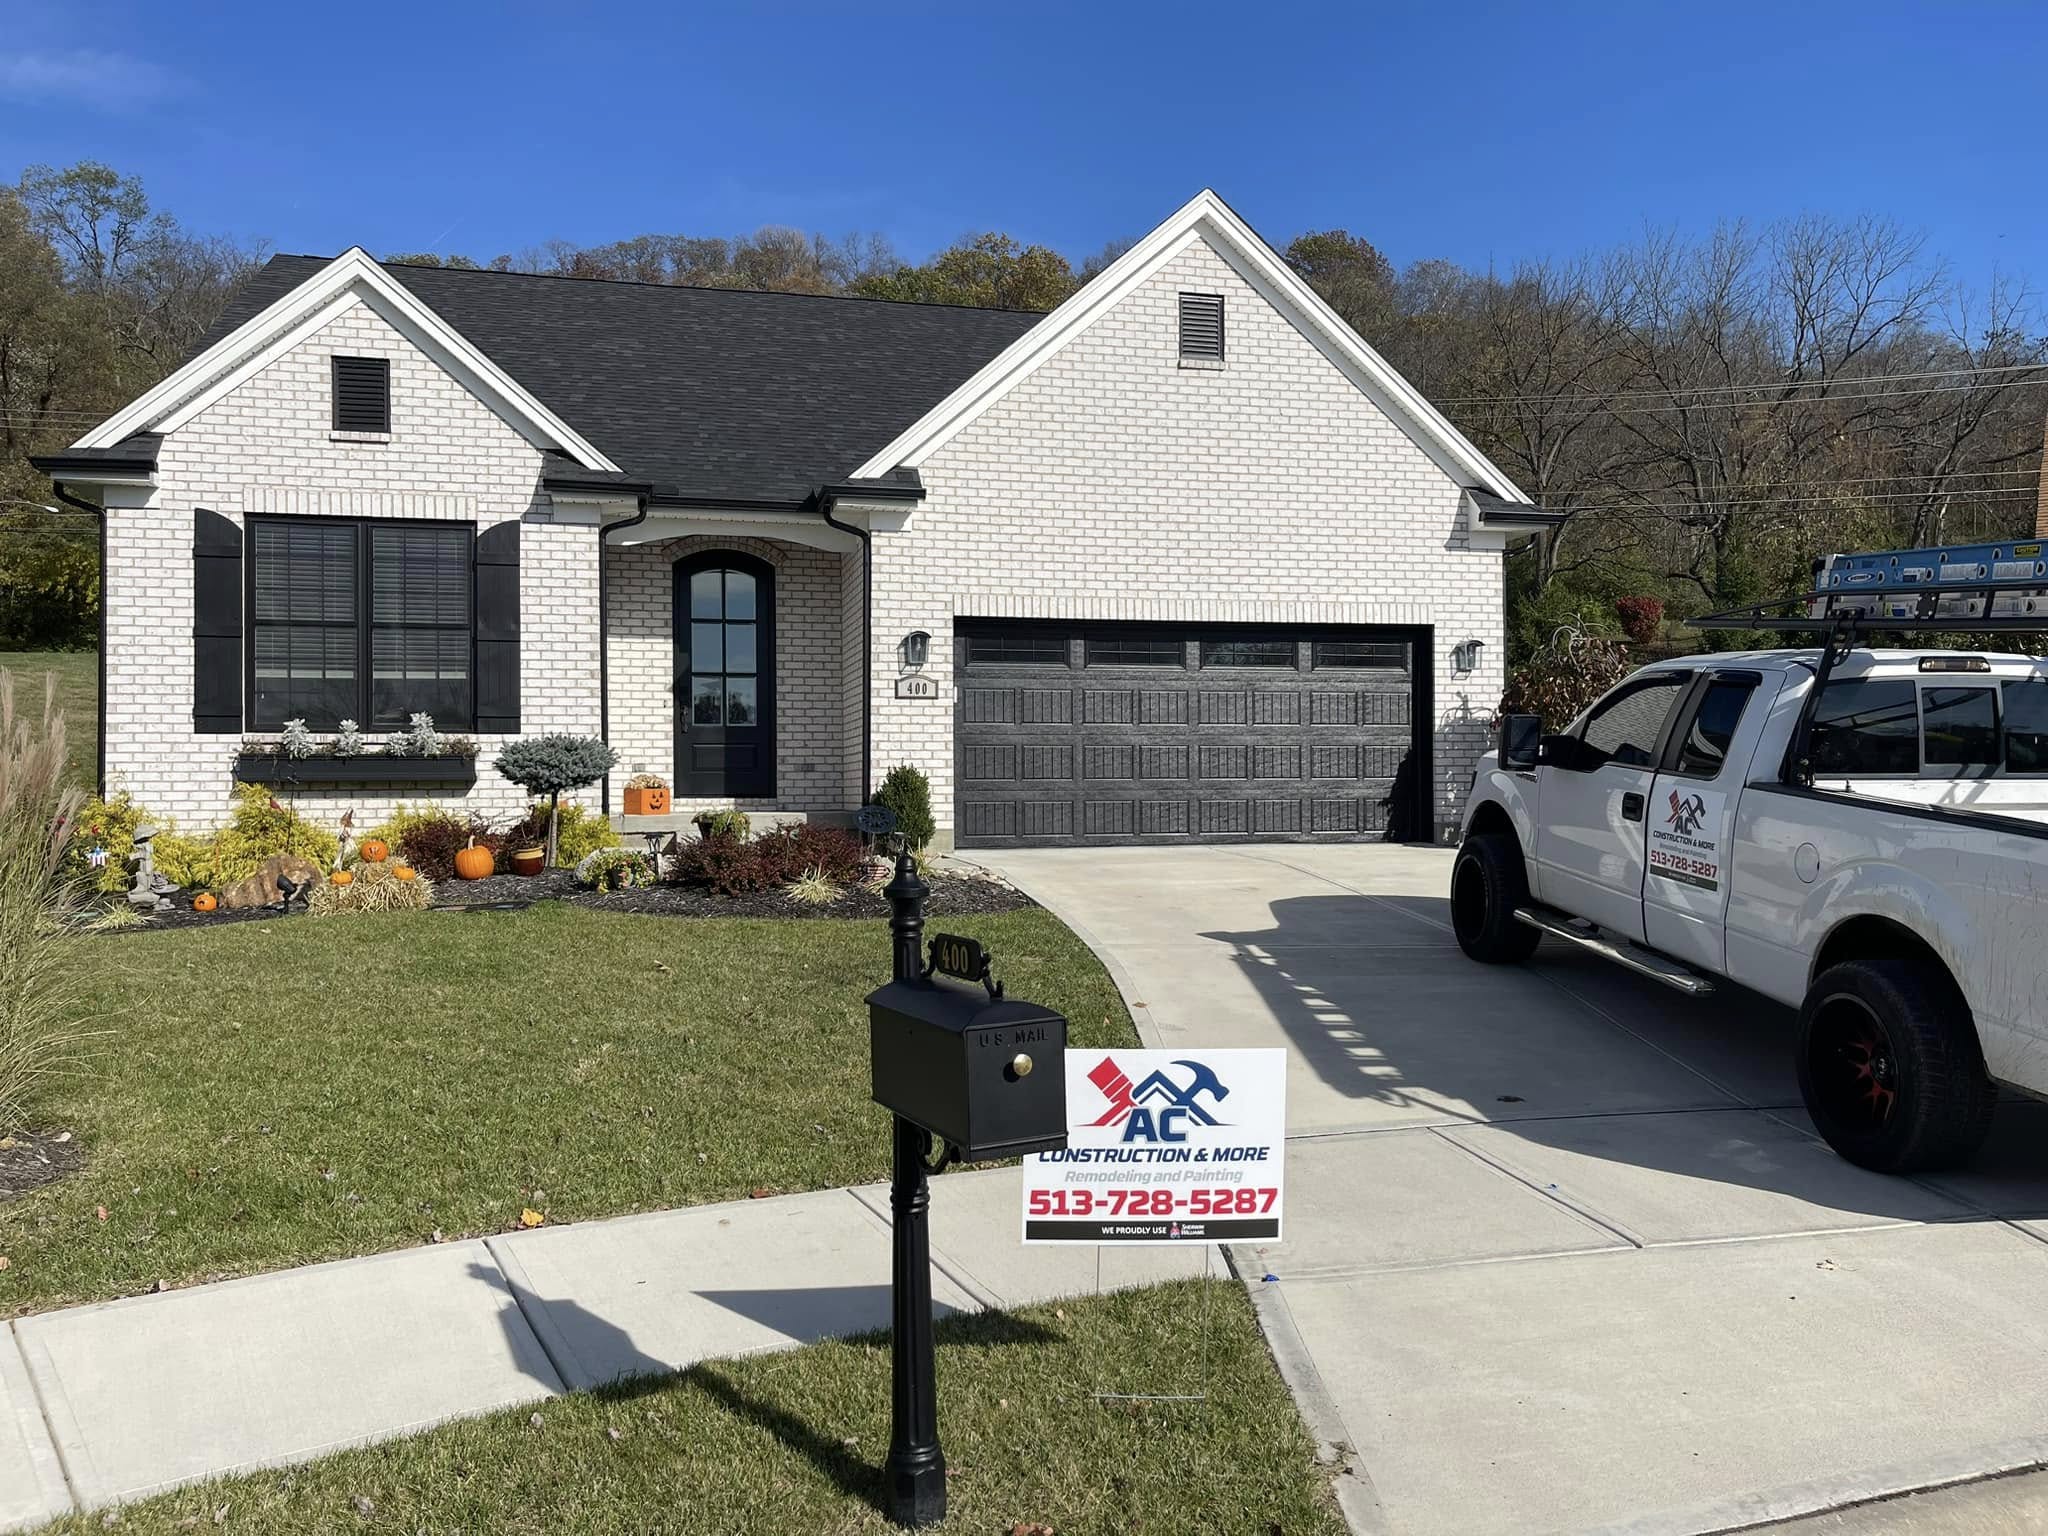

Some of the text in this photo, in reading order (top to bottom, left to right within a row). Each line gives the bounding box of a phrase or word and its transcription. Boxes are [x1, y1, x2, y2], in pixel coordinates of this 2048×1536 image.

[907, 682, 927, 695] 400
[1673, 815, 1693, 835] AC
[1653, 830, 1692, 846] CONSTRUCTION
[1698, 840, 1716, 851] MORE
[1651, 849, 1718, 878] 513-728-5287
[942, 940, 969, 974] 400
[1015, 1027, 1048, 1044] MAIL
[1121, 1107, 1189, 1143] AC
[1039, 1146, 1269, 1163] CONSTRUCTION & MORE
[1064, 1168, 1244, 1185] Remodeling and Painting
[1029, 1189, 1278, 1215] 513-728-5287
[1101, 1226, 1167, 1235] WE PROUDLY USE
